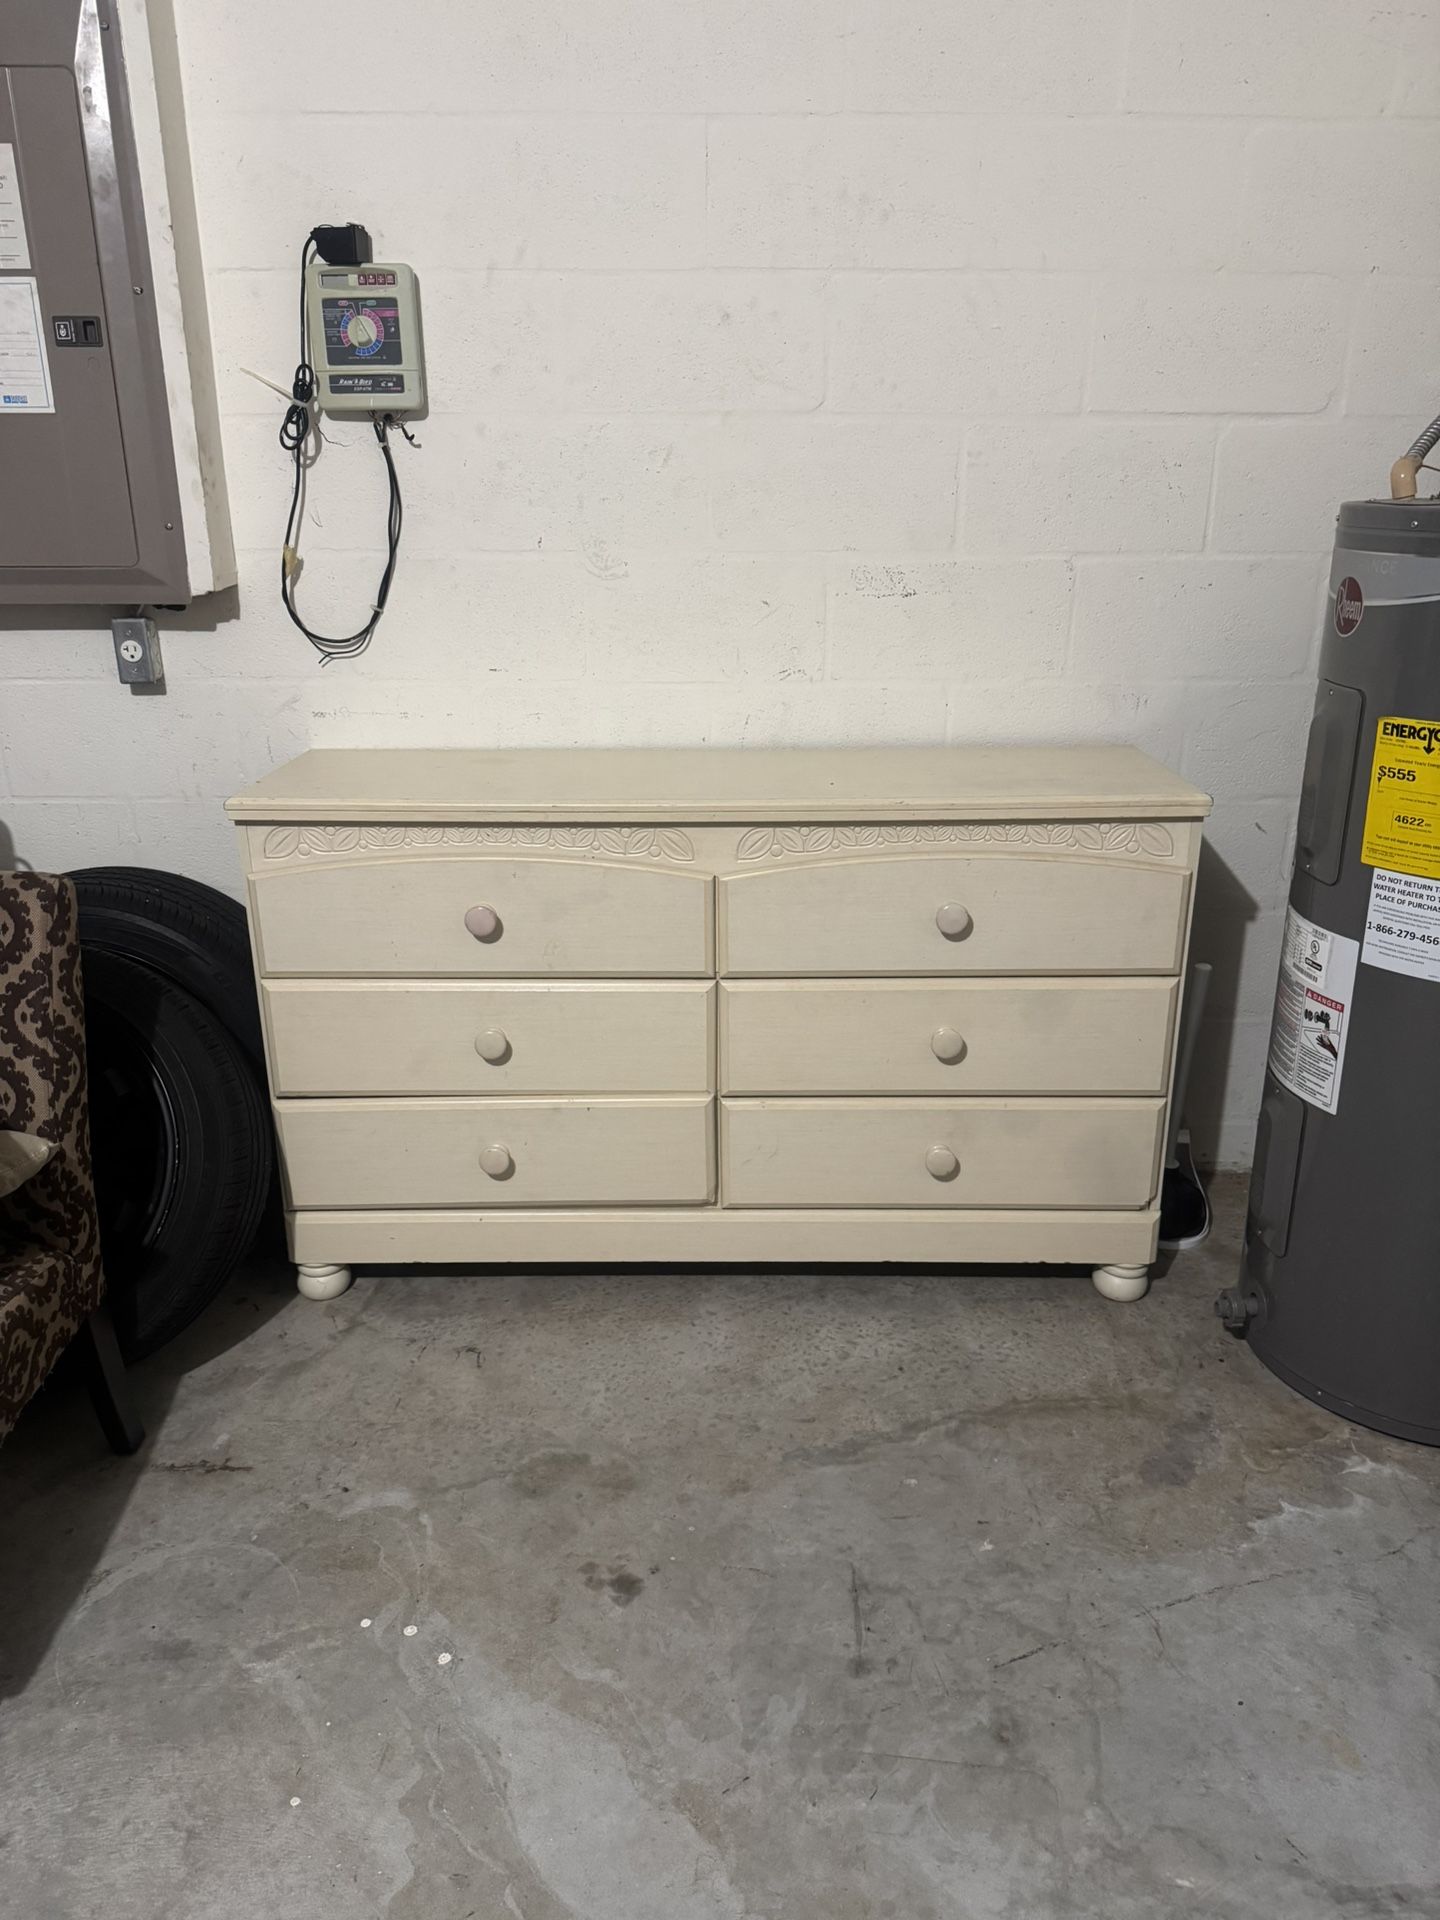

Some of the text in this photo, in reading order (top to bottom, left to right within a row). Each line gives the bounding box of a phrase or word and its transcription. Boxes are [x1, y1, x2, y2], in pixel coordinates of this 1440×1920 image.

[1337, 578, 1361, 627] Rheem
[1377, 765, 1416, 782] $555
[1394, 815, 1425, 827] 4622
[1376, 874, 1387, 882] DO
[1387, 876, 1403, 886] NOT
[1403, 880, 1434, 892] RETURN
[1373, 882, 1396, 894] WATER
[1397, 888, 1424, 900] HEATER
[1426, 894, 1436, 902] TO
[1375, 892, 1396, 904] PLACE
[1396, 898, 1407, 906] OF
[1313, 993, 1343, 1010] DANGER
